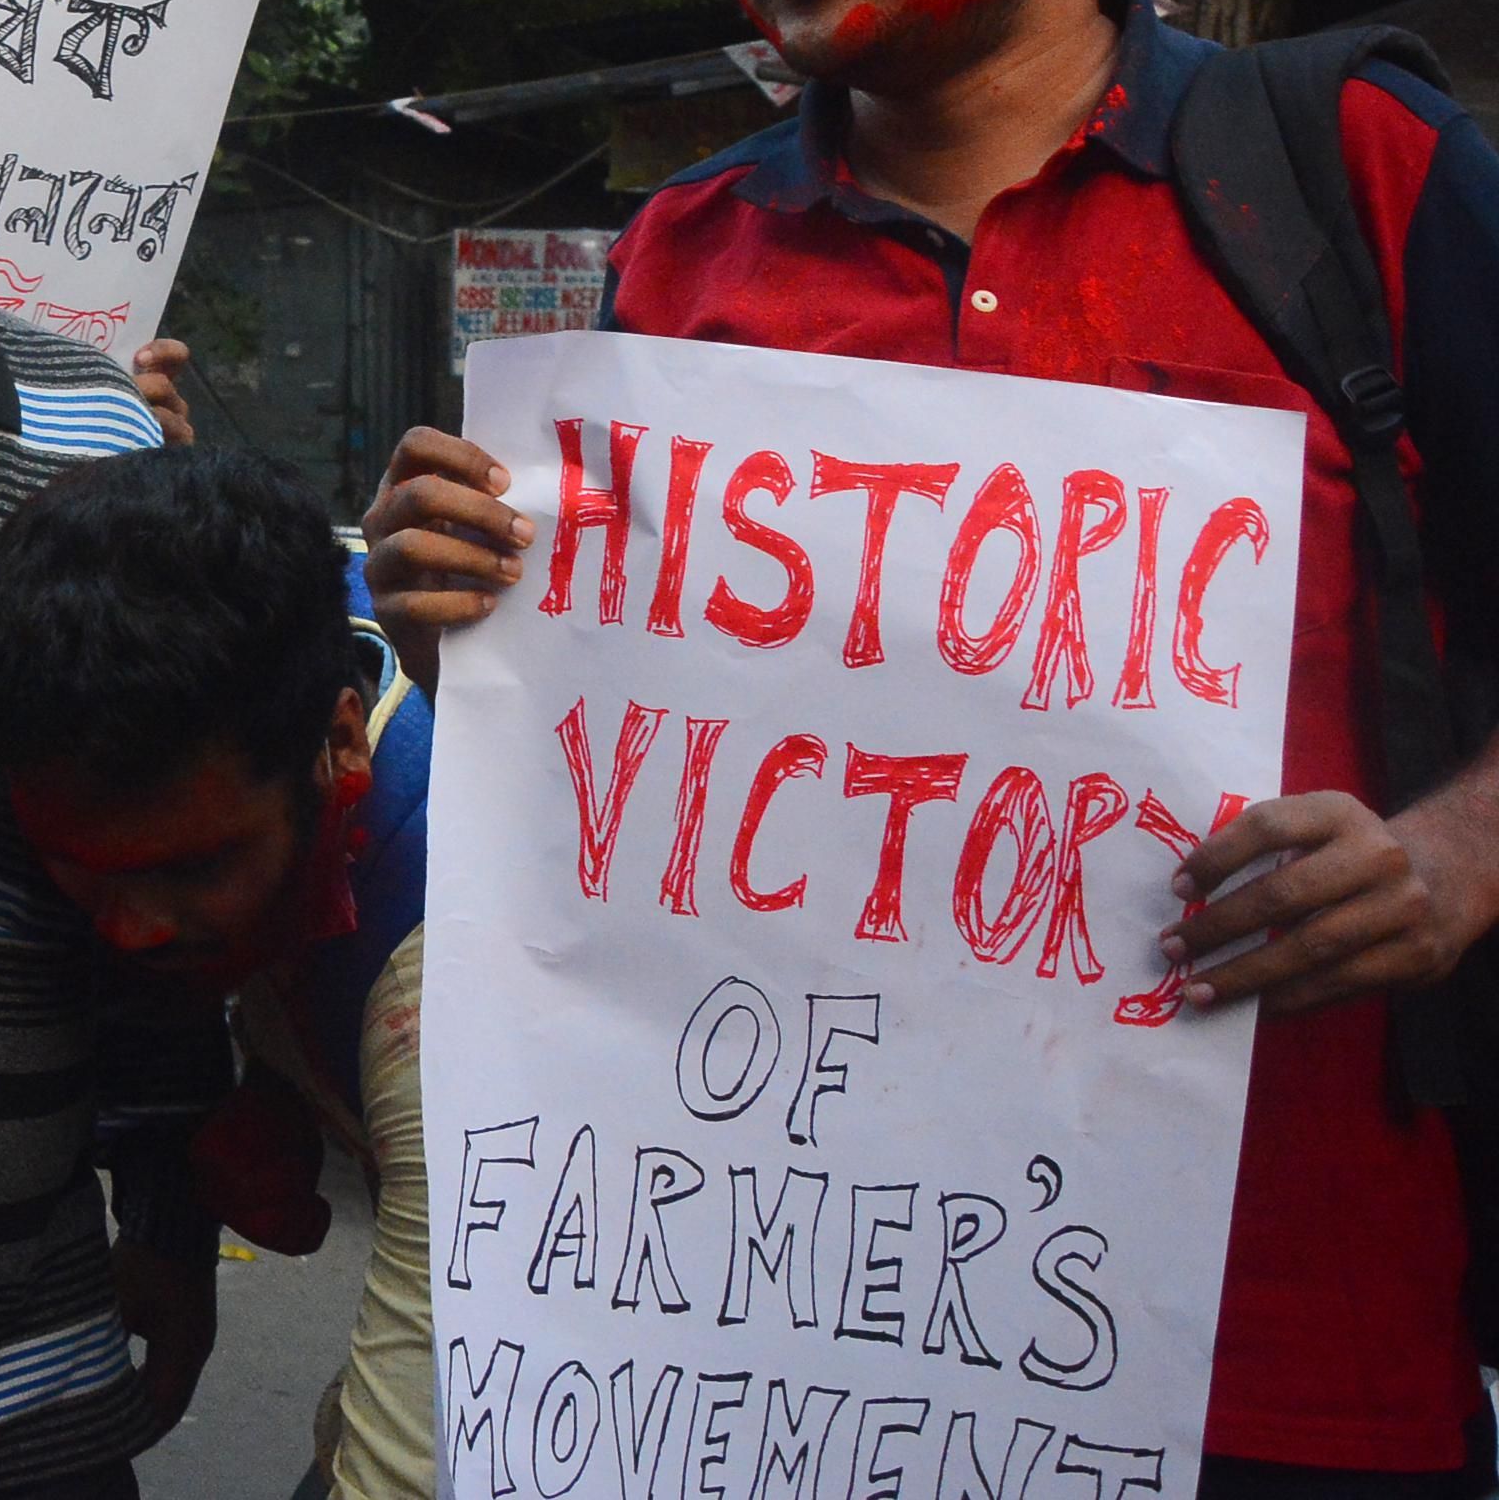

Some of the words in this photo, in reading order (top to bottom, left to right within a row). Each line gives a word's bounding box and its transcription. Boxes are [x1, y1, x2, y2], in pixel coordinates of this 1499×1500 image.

[537, 417, 1271, 710] HISTORIC
[555, 697, 1250, 1027] VICTORY
[676, 975, 881, 1147] OF
[445, 1116, 1120, 1392] FARMER'S
